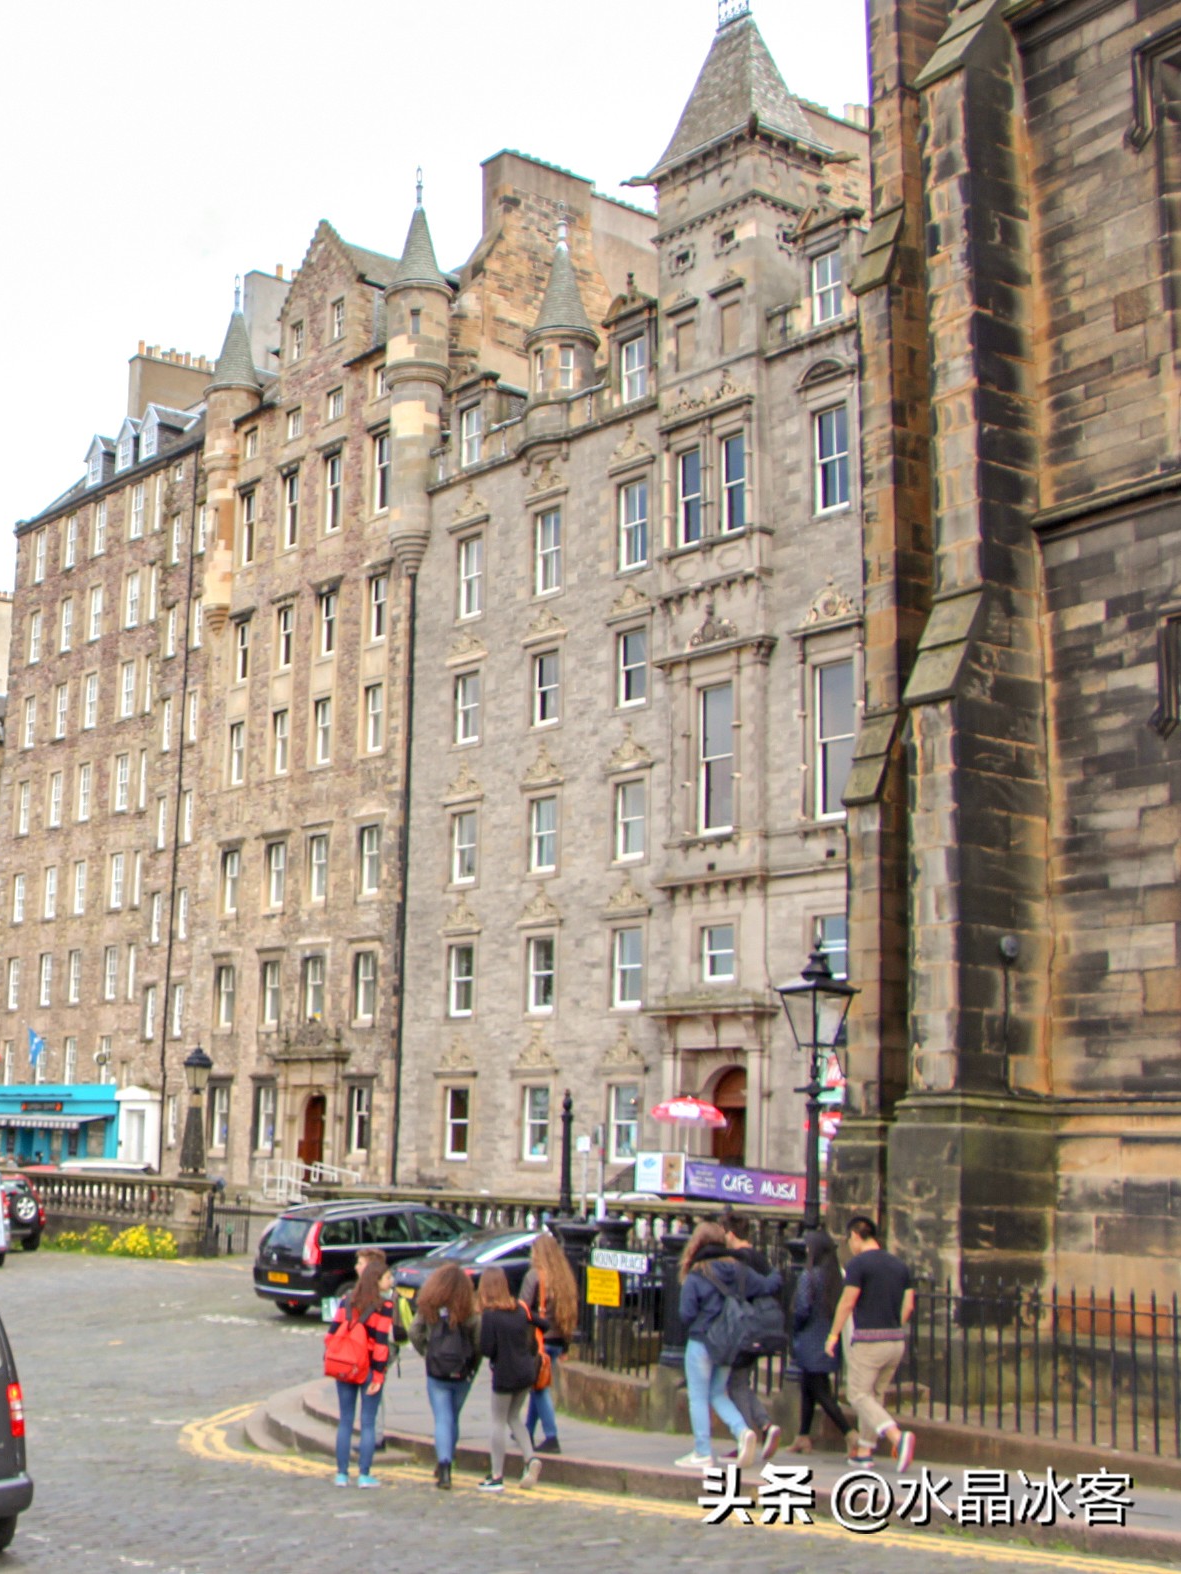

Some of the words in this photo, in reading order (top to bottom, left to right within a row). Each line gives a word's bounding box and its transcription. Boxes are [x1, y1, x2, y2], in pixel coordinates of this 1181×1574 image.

[721, 1172, 755, 1195] CAFE
[759, 1180, 797, 1201] MUSA
[621, 1255, 644, 1271] PLACE
